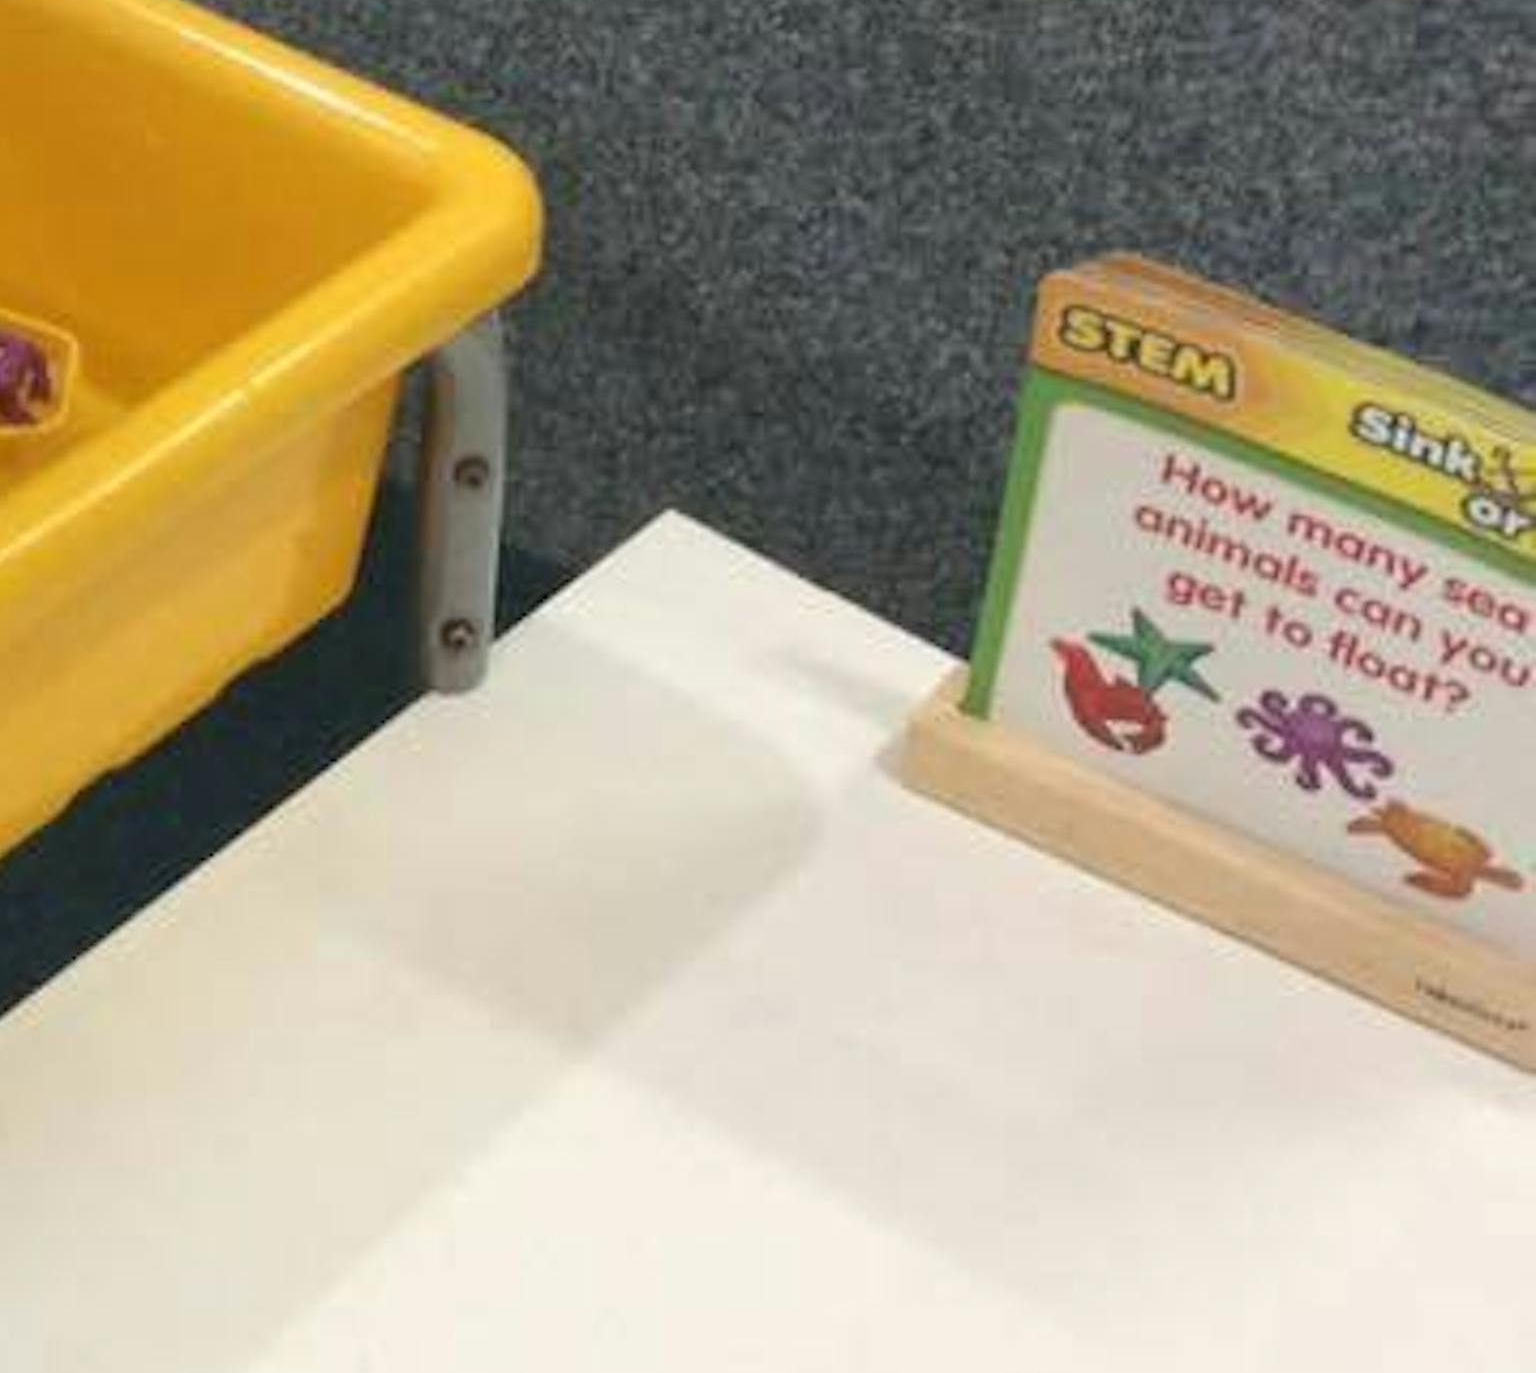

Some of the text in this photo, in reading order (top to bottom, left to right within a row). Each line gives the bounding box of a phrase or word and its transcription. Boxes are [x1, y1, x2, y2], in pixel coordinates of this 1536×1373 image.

[1061, 305, 1235, 401] STEM
[1350, 404, 1479, 483] Sink
[1161, 453, 1530, 635] How many sea
[1462, 492, 1536, 539] or
[1133, 504, 1532, 688] animals can you
[1167, 571, 1470, 713] get to float?
